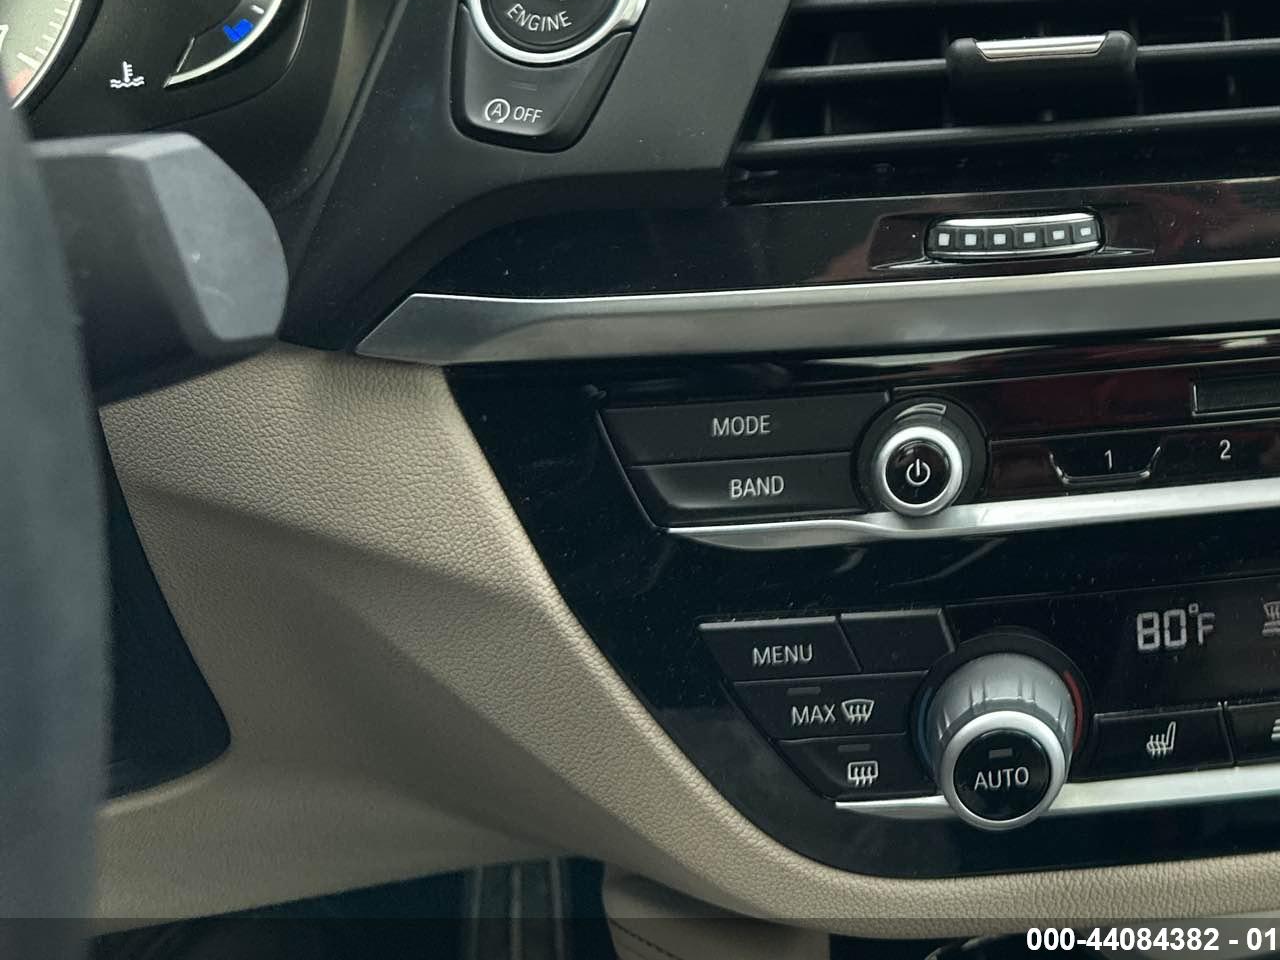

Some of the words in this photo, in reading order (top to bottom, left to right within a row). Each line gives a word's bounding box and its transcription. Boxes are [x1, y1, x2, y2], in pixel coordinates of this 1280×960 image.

[507, 3, 572, 31] ENGINE
[514, 106, 543, 123] OFF
[712, 414, 771, 437] MODE
[1104, 449, 1114, 470] 1
[1219, 439, 1232, 459] 2
[729, 475, 785, 498] BAND
[752, 643, 814, 666] MENU
[791, 703, 836, 725] MAX
[974, 766, 1029, 790] AUTO
